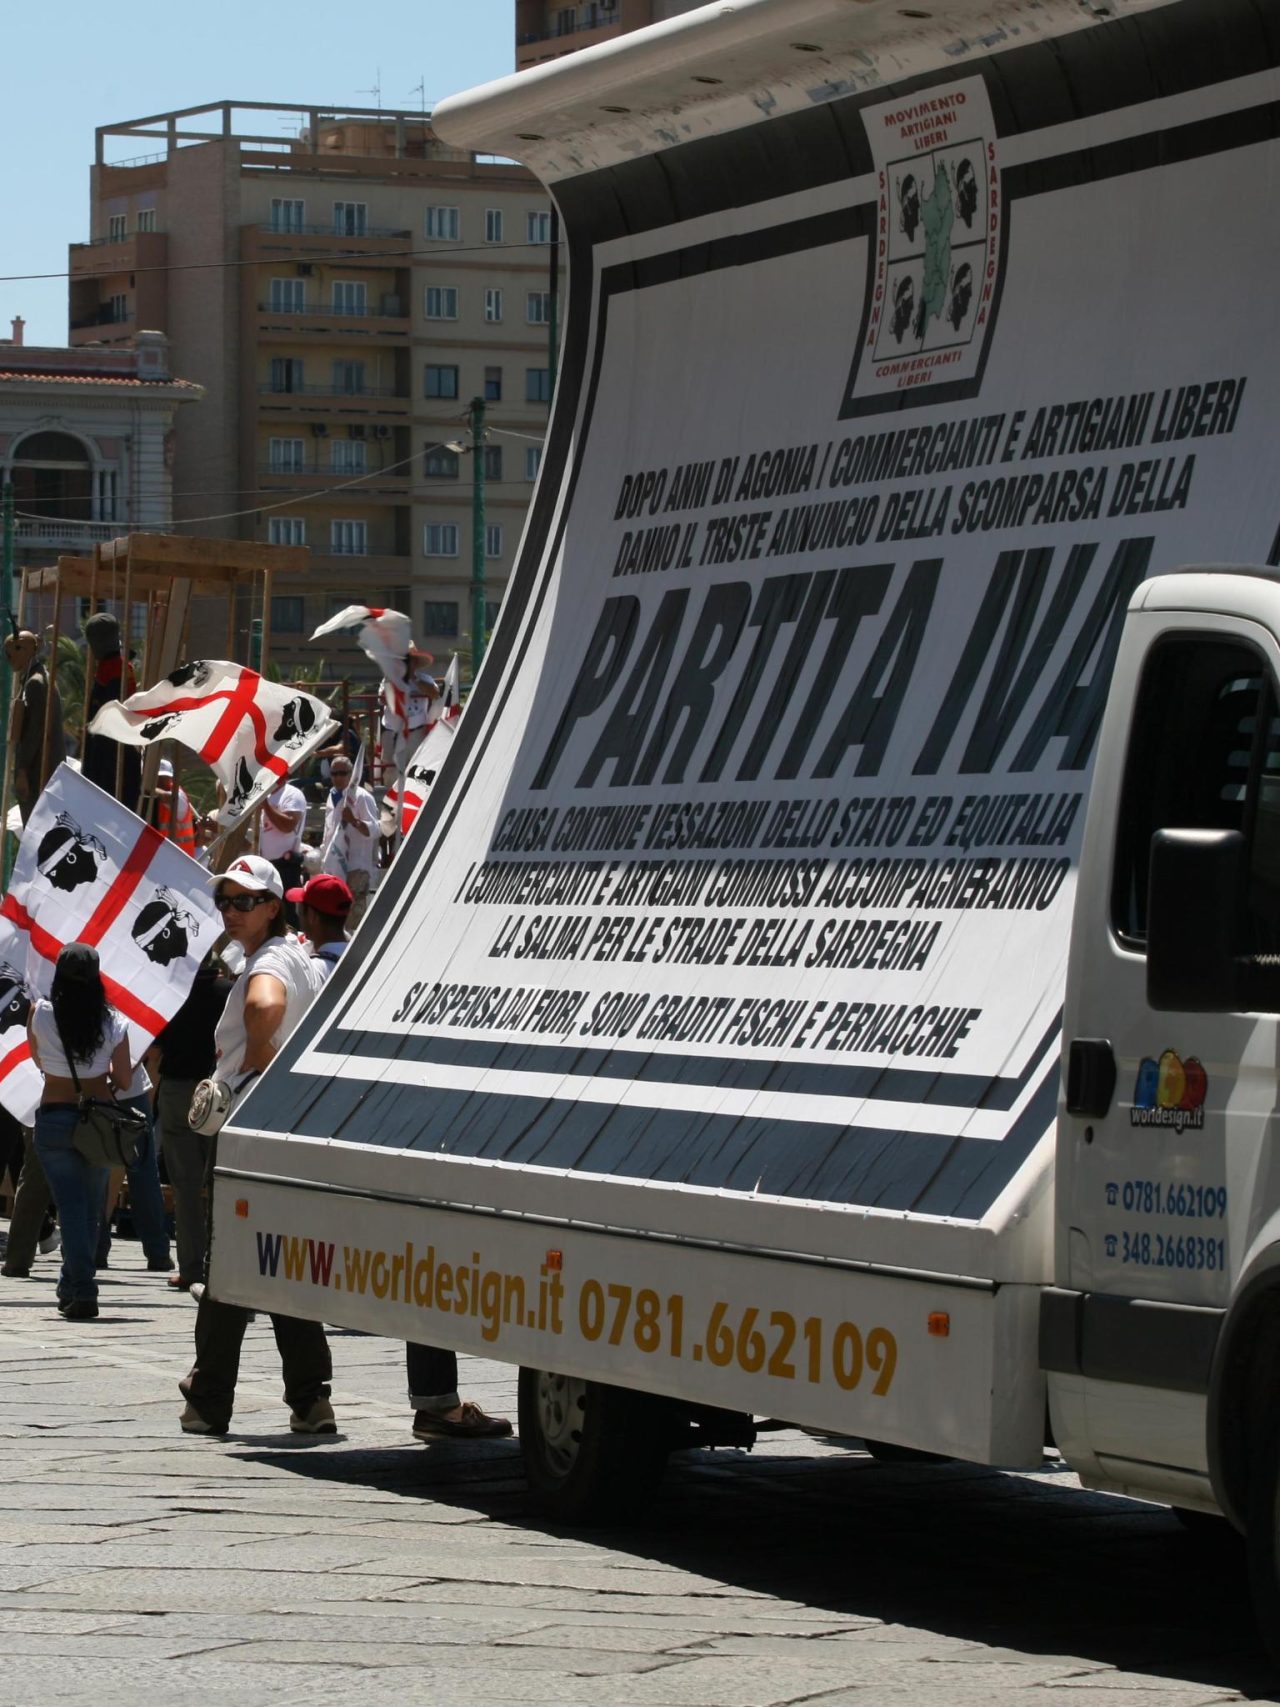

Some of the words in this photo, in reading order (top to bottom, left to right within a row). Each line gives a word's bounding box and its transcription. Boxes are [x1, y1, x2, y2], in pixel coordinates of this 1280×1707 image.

[883, 92, 967, 127] MOVIMENTO
[900, 111, 958, 139] ARTIGIANI
[913, 129, 948, 150] LIBERI
[977, 141, 998, 326] SARDEGNA
[866, 171, 887, 347] SARDEGNA
[875, 350, 962, 378] COMMERCIANTI
[896, 371, 932, 388] LIBERI
[613, 468, 669, 521] DOPO
[662, 460, 716, 513] ANNI
[711, 456, 740, 506] DI
[735, 444, 819, 502] AGONIA
[815, 441, 834, 490] I
[828, 413, 1006, 489] COMMERCIANTI
[1000, 410, 1027, 463] E
[1020, 391, 1156, 461] ARTIGIANI
[1150, 376, 1248, 444] LIBERI
[612, 523, 681, 578] DANNO
[674, 521, 699, 570] IL
[699, 511, 774, 567] TRISTE
[765, 494, 881, 558] ANNUNCIO
[875, 485, 953, 543] DELLA
[950, 466, 1109, 535] SCOMPARSA
[1106, 453, 1197, 518] DELLA
[528, 557, 945, 790] PARTITA
[911, 535, 1156, 775] IVA
[490, 806, 560, 852] CAUSA
[551, 804, 653, 851] CONTINUE
[643, 800, 772, 850] VESSAZIONI
[760, 797, 840, 848] DELLO
[830, 796, 917, 847] STATO
[904, 795, 954, 847] ED
[943, 792, 1084, 855] EQUITALIA
[453, 861, 477, 904] I
[463, 860, 610, 906] COMMERCIANTI
[591, 860, 622, 906] E
[606, 859, 716, 907] ARTIGIANI
[703, 858, 831, 908] COMMOSSI
[820, 856, 1072, 912] ACCOMPAGNERANNO
[488, 914, 526, 958] LA
[513, 915, 593, 960] SALMA
[580, 916, 636, 963] PER
[622, 916, 665, 963] LE
[652, 916, 748, 966] STRADE
[732, 918, 815, 967] DELLA
[804, 918, 943, 971] SARDEGNA
[391, 981, 429, 1023] SI
[412, 982, 513, 1030] DISPENSA
[496, 987, 542, 1032] DAI
[531, 989, 590, 1044] FIORI,
[579, 991, 651, 1039] SONO
[635, 994, 736, 1045] GRADITI
[729, 998, 809, 1048] FISCHI
[790, 1000, 828, 1049] E
[810, 1001, 983, 1059] PERNACCHIE
[1130, 1106, 1203, 1134] worldesign.it
[1123, 1181, 1227, 1219] 0781.662109
[1122, 1231, 1224, 1271] 348.2668381
[579, 1278, 898, 1397] 0781.662109
